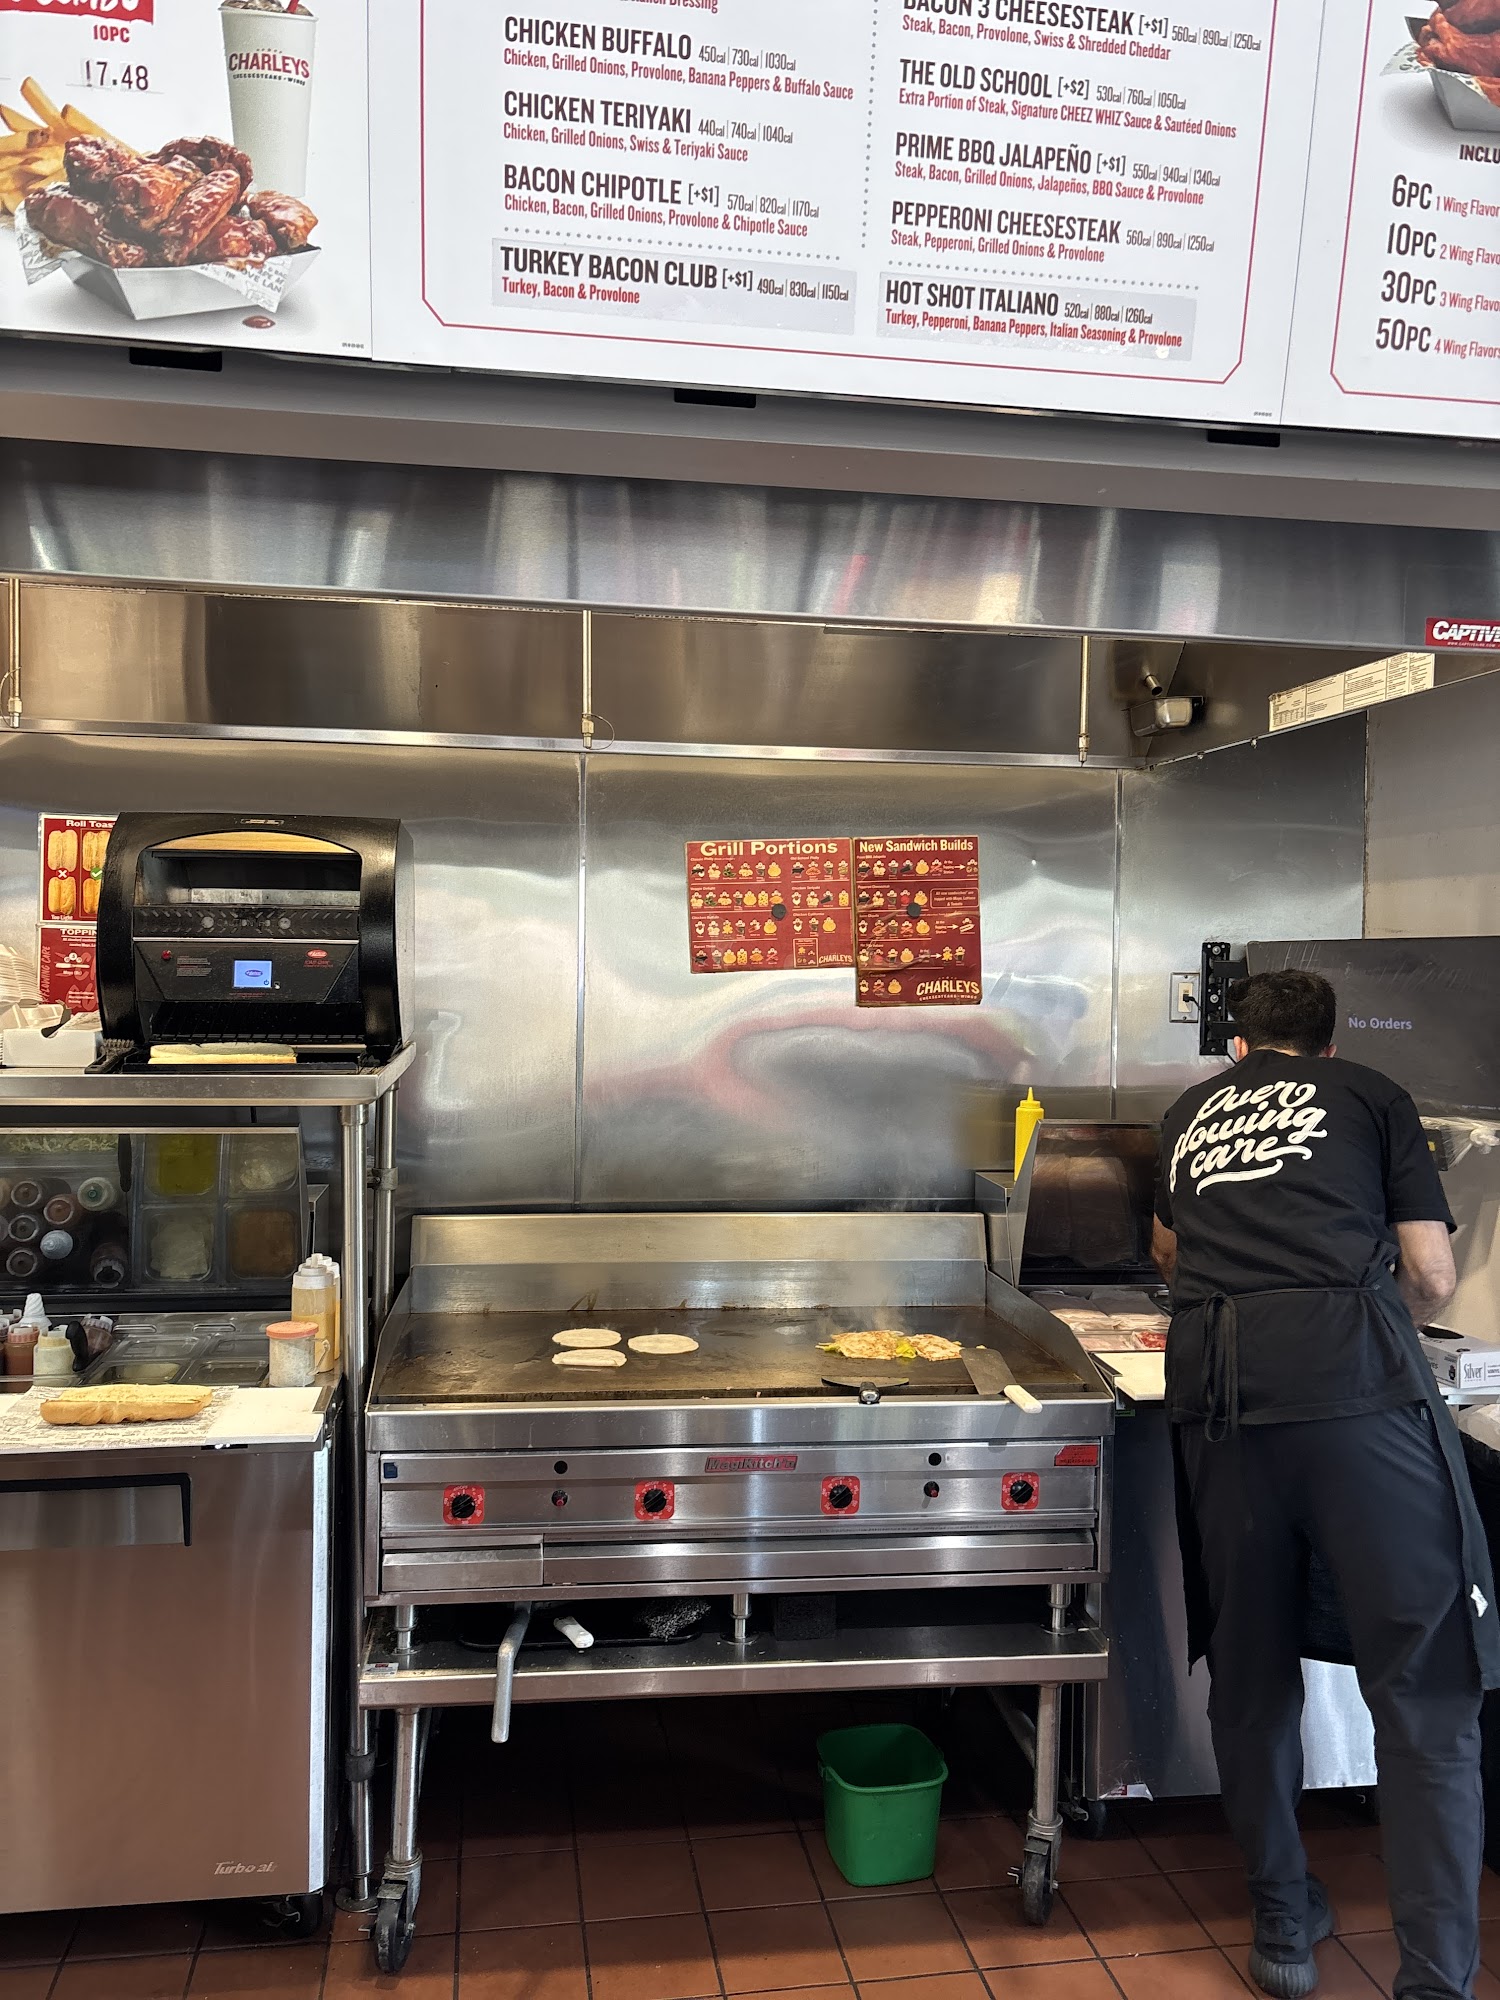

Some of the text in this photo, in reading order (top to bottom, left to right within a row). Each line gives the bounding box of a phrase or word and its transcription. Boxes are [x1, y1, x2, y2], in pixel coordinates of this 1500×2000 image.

[92, 24, 130, 43] 10PC
[978, 0, 989, 18] 3
[996, 0, 1134, 35] CHEESESTEAK
[505, 16, 596, 50] CHICKEN
[601, 27, 692, 60] BUFFALO
[902, 15, 1171, 61] Steak, Bacon, Provolone, Swiss & Shredded Cheddar
[228, 52, 310, 79] CHARLEYS
[504, 48, 854, 99] Chicken, Grilled Onions, Provolone, Banana Peppers & Buffalo Sauce
[901, 59, 935, 86] THE
[940, 63, 974, 90] OLD
[980, 67, 1052, 98] SCHOOL
[504, 91, 595, 124] CHICKEN
[600, 101, 691, 133] TERIYAKI
[899, 89, 924, 106] Extra
[927, 94, 964, 111] Portion
[966, 97, 976, 112] of
[978, 98, 1009, 117] Steak,
[1011, 101, 1058, 123] Signature
[1061, 107, 1092, 124] CHEEZ
[1124, 112, 1152, 130] Sauce
[1154, 116, 1162, 131] &
[1205, 121, 1236, 138] Onions
[504, 122, 748, 161] Chicken, Grilled Onions, Swiss & Teriyaki Sauce
[896, 132, 954, 161] PRIME
[959, 138, 995, 166] BBQ
[999, 143, 1091, 174] JALAPEÑO
[504, 164, 575, 195] BACON
[581, 174, 681, 204] CHIPOTLE
[895, 162, 926, 182] Steak,
[929, 167, 962, 186] Bacon,
[965, 170, 997, 187] Grilled
[1000, 174, 1035, 193] Onions,
[1092, 181, 1112, 199] BBQ
[1115, 183, 1144, 200] Sauce
[1146, 186, 1155, 200] &
[1158, 186, 1203, 205] Provolone
[1392, 174, 1432, 210] 6PC
[1437, 196, 1440, 211] 1
[1443, 197, 1467, 217] Wing
[505, 194, 808, 237] Chicken, Bacon, Grilled Onions, Provolone & Chipotle Sauce
[892, 201, 1121, 244] PEPPERONI CHEESESTEAK
[891, 229, 1104, 263] Steak, Pepperoni, Grilled Onions & Provolone
[1387, 223, 1436, 258] 10PC
[1440, 244, 1446, 259] 2
[1450, 246, 1473, 265] Wing
[501, 247, 584, 277] TURKEY
[588, 255, 659, 285] BACON
[664, 263, 717, 288] CLUB
[502, 277, 640, 304] Turkey, Bacon & Provolone
[886, 280, 1058, 316] HOT SHOT ITALIANO
[1381, 270, 1436, 305] 30PC
[1440, 292, 1446, 307] 3
[1450, 293, 1472, 312] Wing
[886, 309, 1182, 347] Turkey, Pepperoni, Banana Peppers, Italian Seasoning & Provolone
[1376, 318, 1431, 352] 50PC
[1435, 339, 1440, 351] 4
[1443, 339, 1466, 359] Wing
[66, 819, 116, 828] Roll Toas
[700, 841, 838, 857] Grill Portions
[859, 838, 974, 853] New Sandwich Builds
[818, 954, 853, 964] CHARLEYS
[916, 980, 980, 996] CHARLEYS
[1349, 1016, 1413, 1030] No Orders
[1463, 1363, 1483, 1379] Silver
[214, 1860, 257, 1875] Turbo
